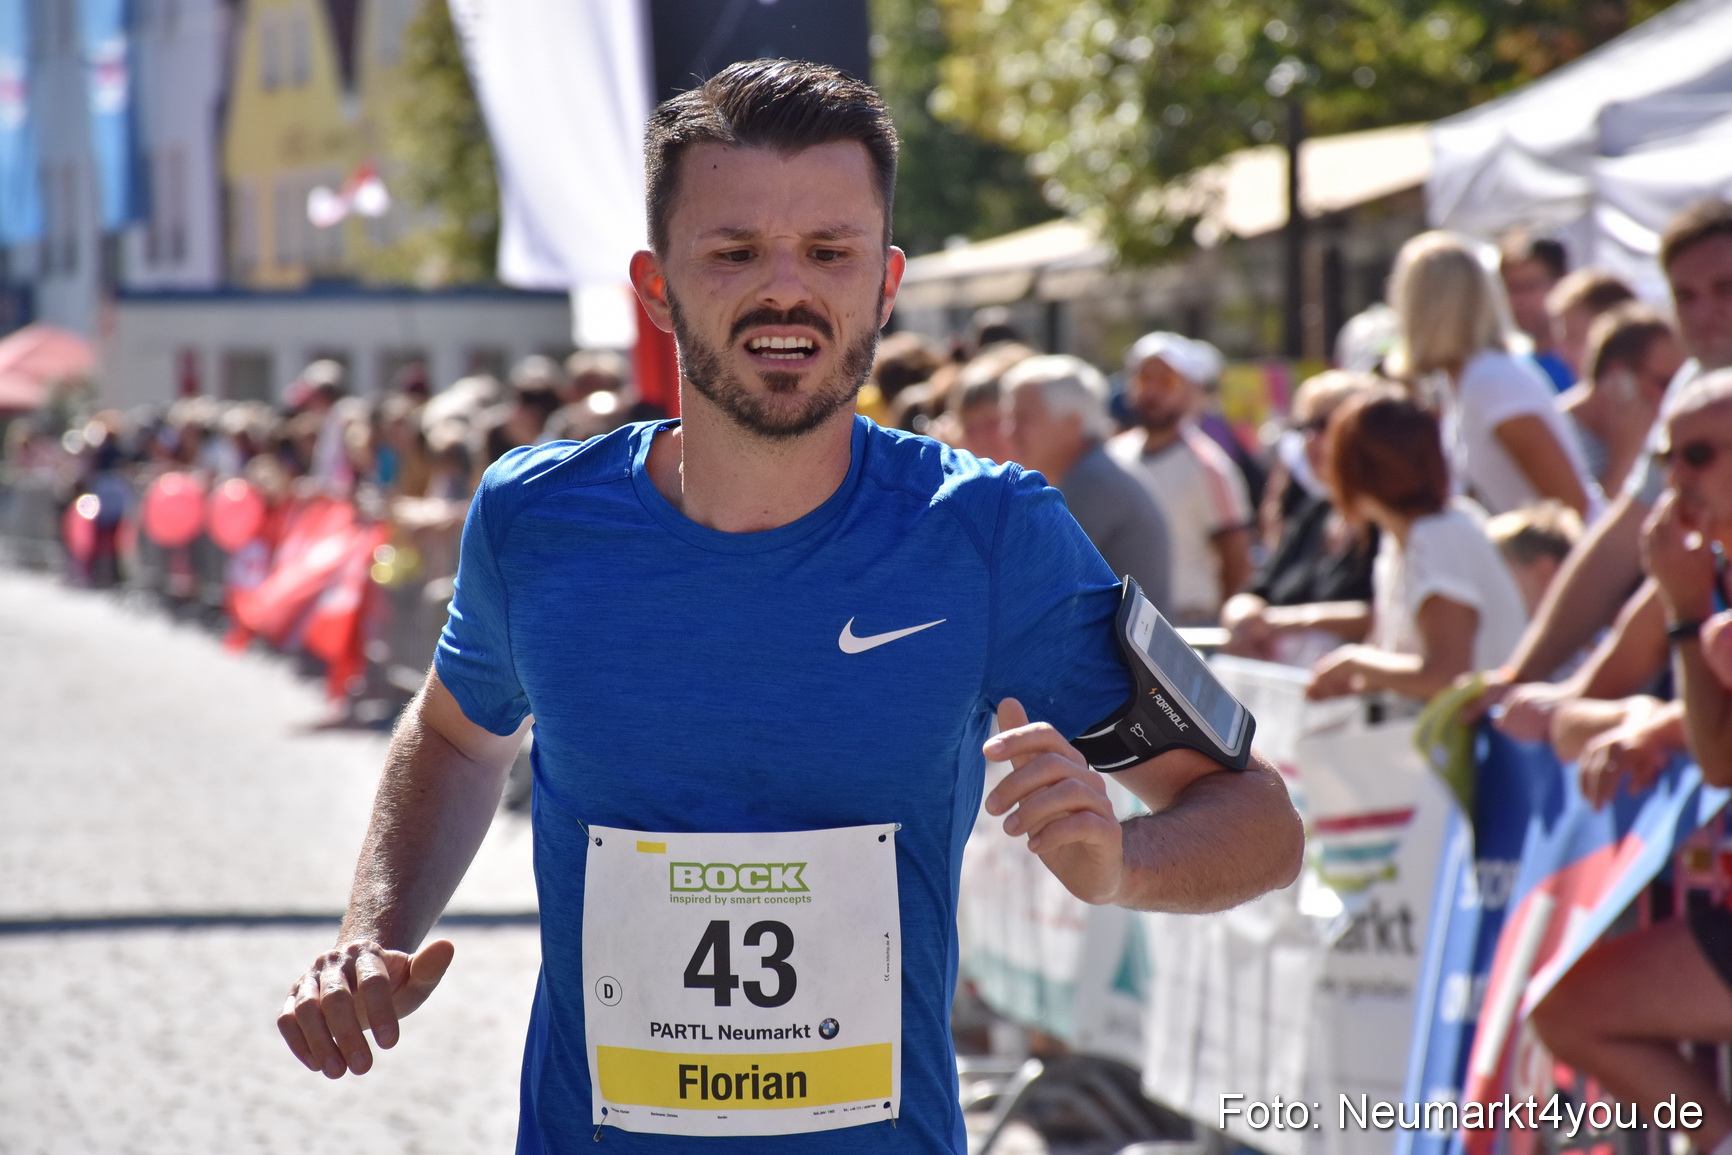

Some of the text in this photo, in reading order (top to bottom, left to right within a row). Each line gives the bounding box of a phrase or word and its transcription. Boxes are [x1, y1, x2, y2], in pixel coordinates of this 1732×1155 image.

[1152, 693, 1189, 732] PORTHOLIC
[670, 862, 810, 892] BOCK
[670, 894, 812, 906] inspired by smart concepts
[683, 920, 797, 1008] 43
[603, 983, 614, 999] D
[650, 1022, 713, 1040] PARTL
[718, 1024, 811, 1040] Neumarkt
[679, 1064, 807, 1100] Florian
